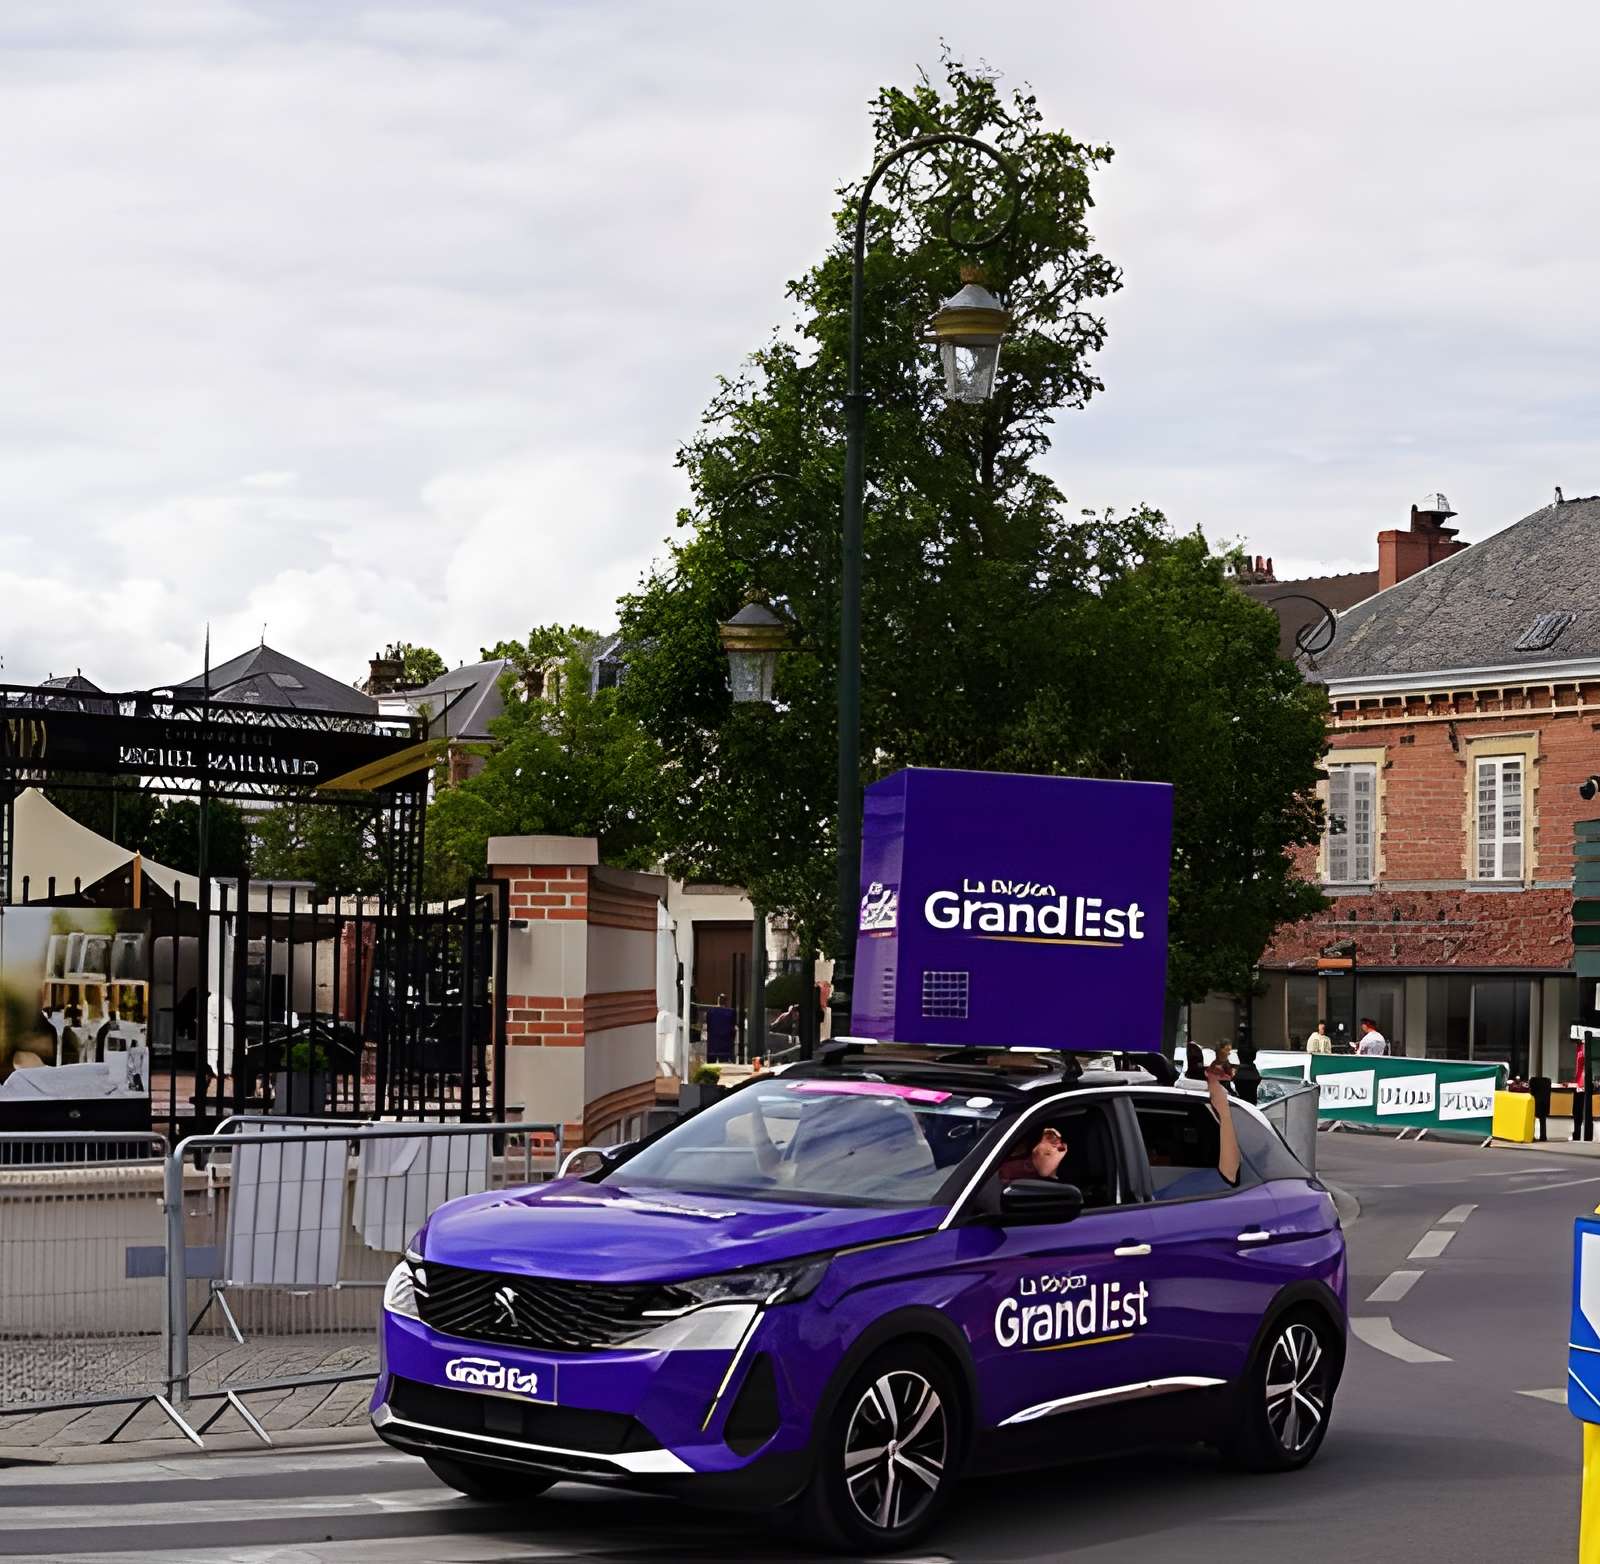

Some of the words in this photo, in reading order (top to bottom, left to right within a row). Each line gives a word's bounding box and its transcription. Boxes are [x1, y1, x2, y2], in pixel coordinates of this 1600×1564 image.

[924, 890, 1068, 936] Grand
[1075, 896, 1145, 939] Est
[994, 1284, 1097, 1347] Grand
[1102, 1278, 1149, 1331] Est
